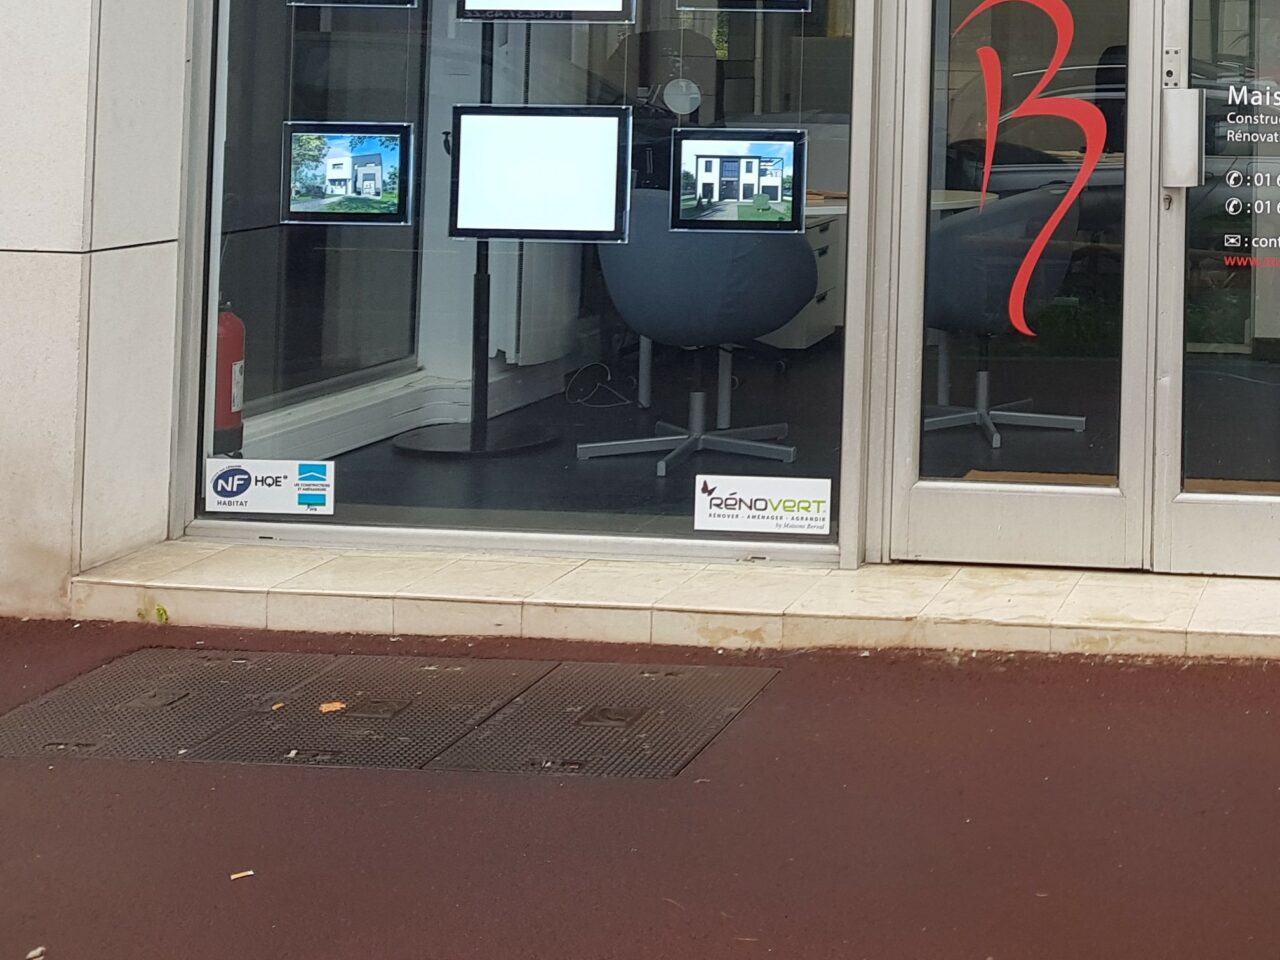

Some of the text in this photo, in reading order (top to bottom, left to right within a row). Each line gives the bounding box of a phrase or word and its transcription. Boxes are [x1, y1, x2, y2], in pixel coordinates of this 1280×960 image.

[1254, 173, 1271, 187] 01
[1254, 200, 1271, 214] 01
[217, 474, 249, 492] NF
[217, 499, 249, 507] HABITAT
